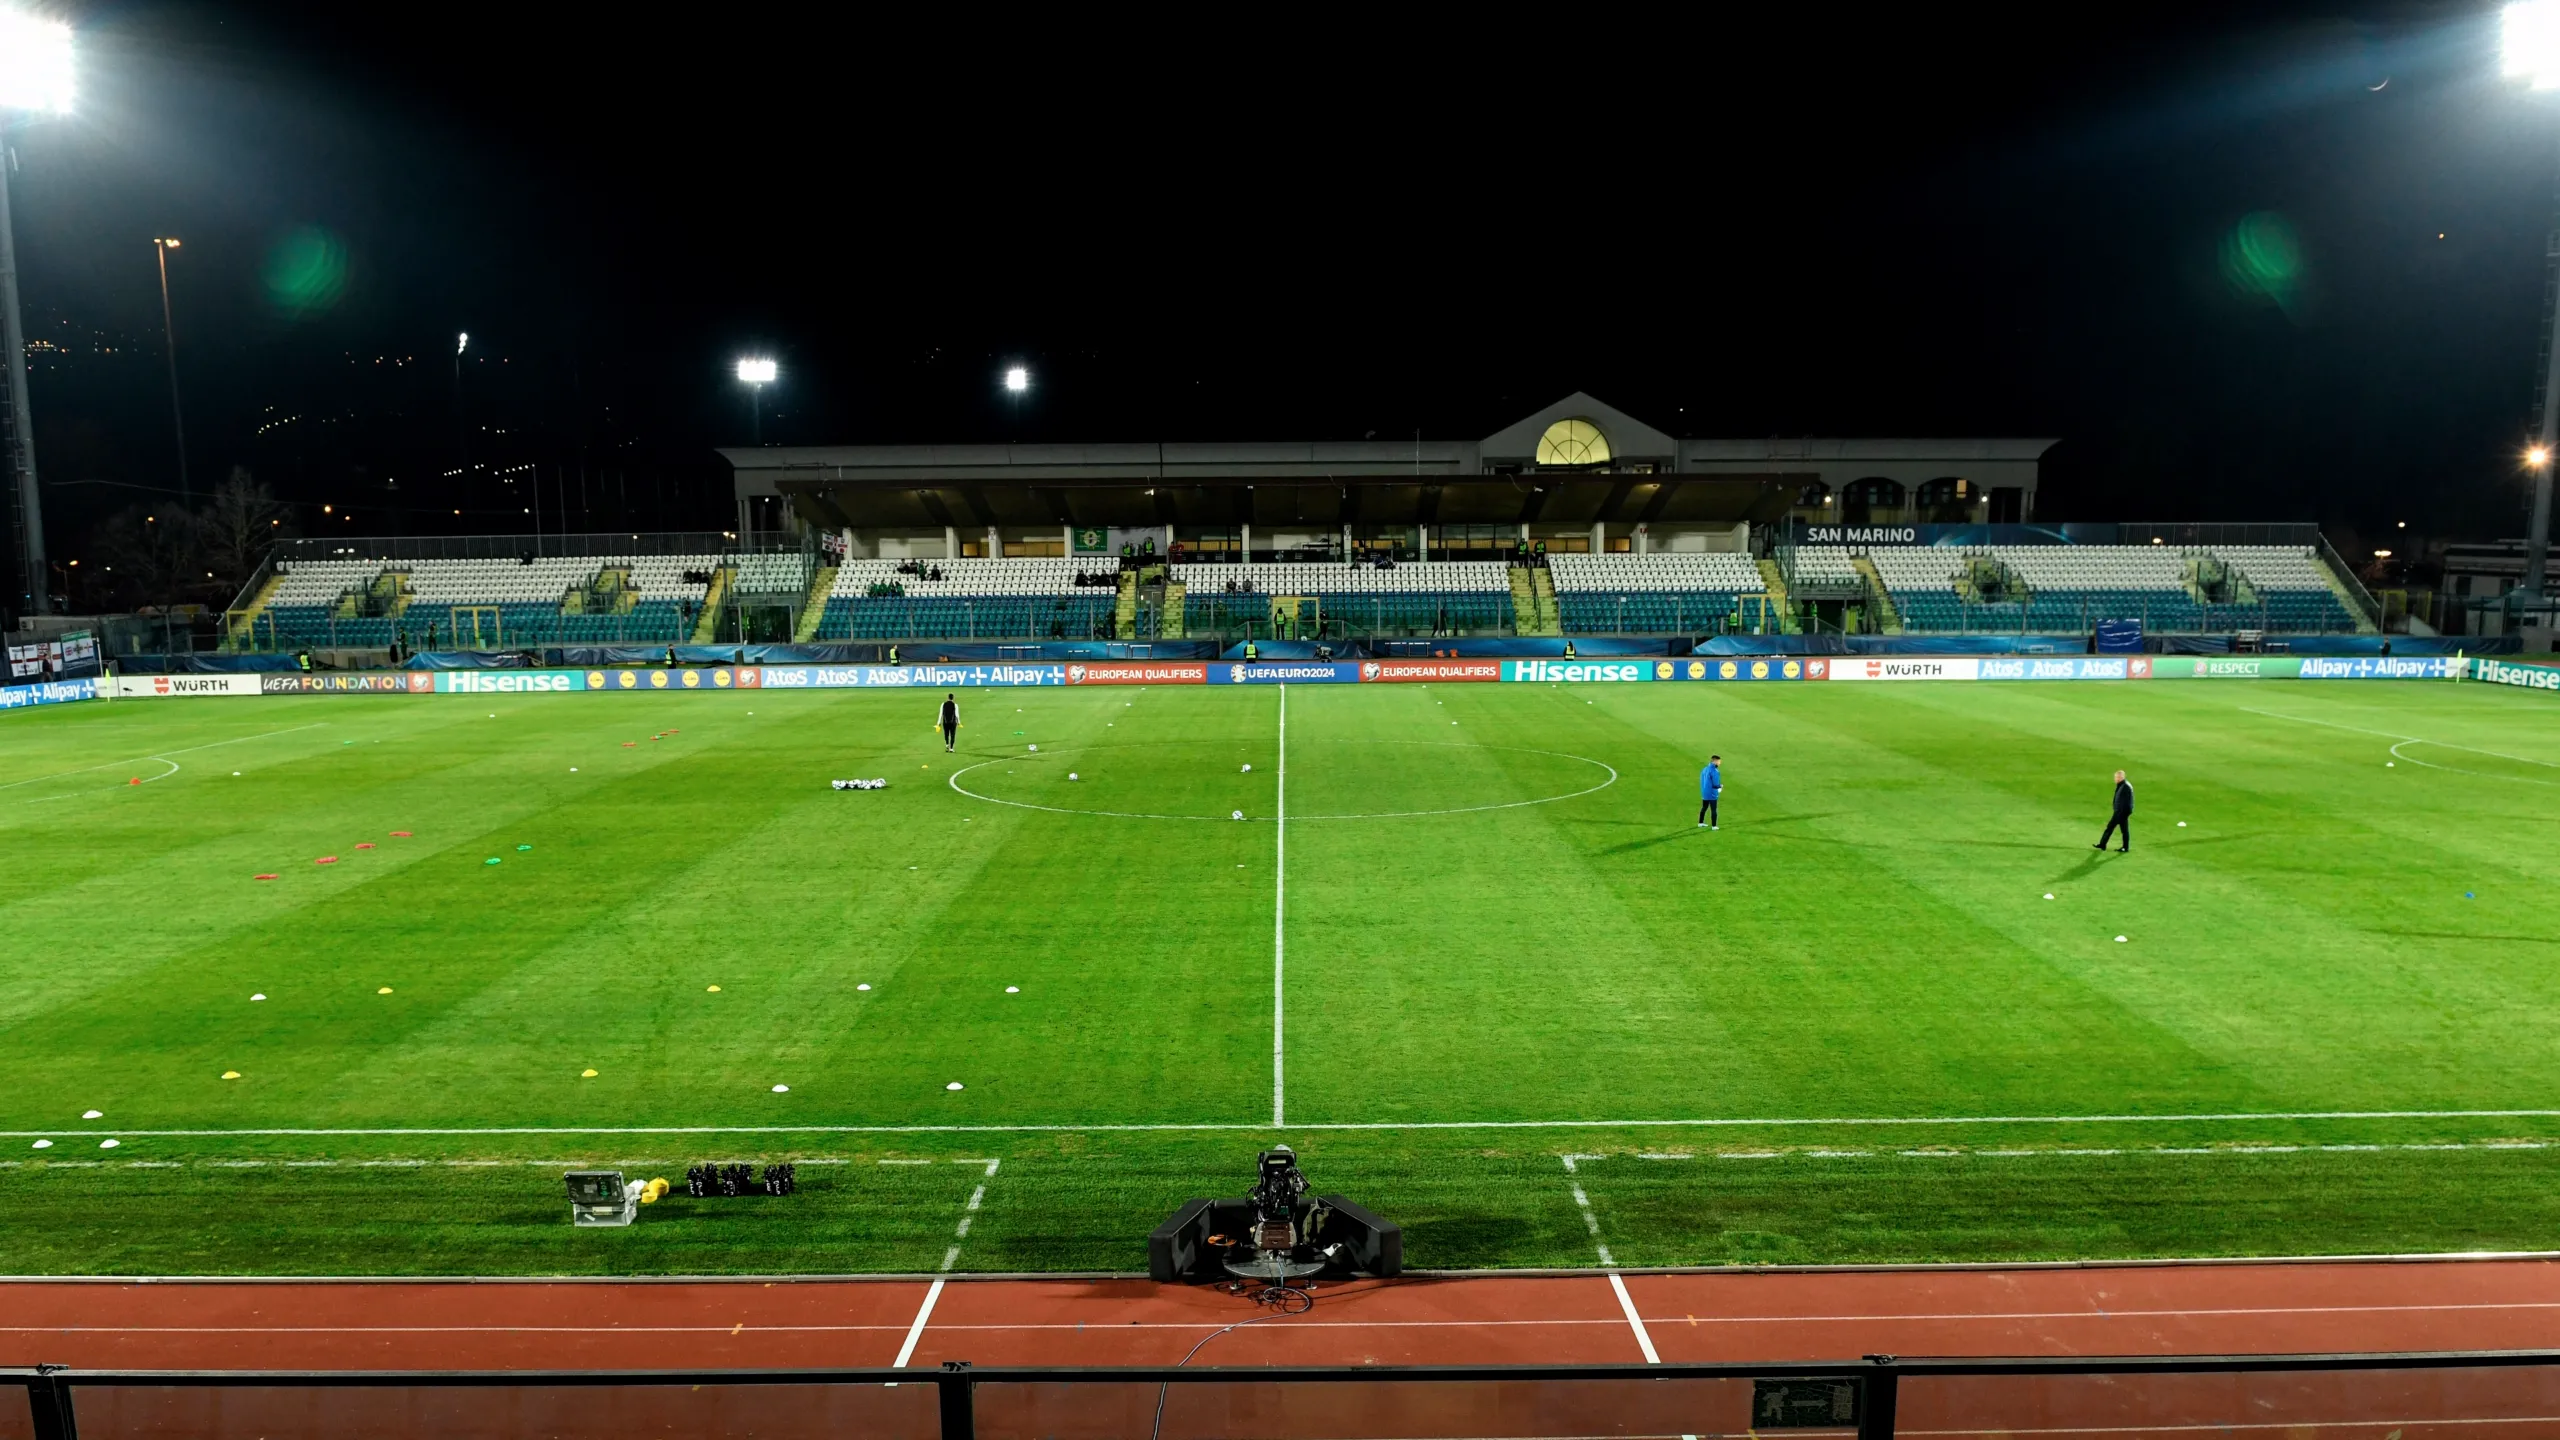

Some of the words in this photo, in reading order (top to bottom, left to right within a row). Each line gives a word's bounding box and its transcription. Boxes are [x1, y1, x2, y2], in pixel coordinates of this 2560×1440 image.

[1807, 528, 1841, 542] SAN
[1846, 528, 1915, 542] MARINO
[1089, 669, 1143, 679] EUROPEAN
[1145, 669, 1203, 680] QUALIFIERS
[1383, 667, 1437, 677] EUROPEAN
[1439, 666, 1497, 677] QUALIFIERS
[1514, 661, 1639, 682] Hisense
[1886, 663, 1942, 676] WÜRTH
[2210, 662, 2260, 674] RESPECT
[2300, 658, 2353, 678] Alipay
[2374, 658, 2427, 678] Alipay
[2477, 658, 2560, 690] Hisense
[448, 671, 571, 692] Hisense
[914, 667, 967, 685] Alipay
[990, 666, 1044, 685] Alipay
[173, 680, 229, 691] WÜRTH
[263, 677, 300, 691] UEFA
